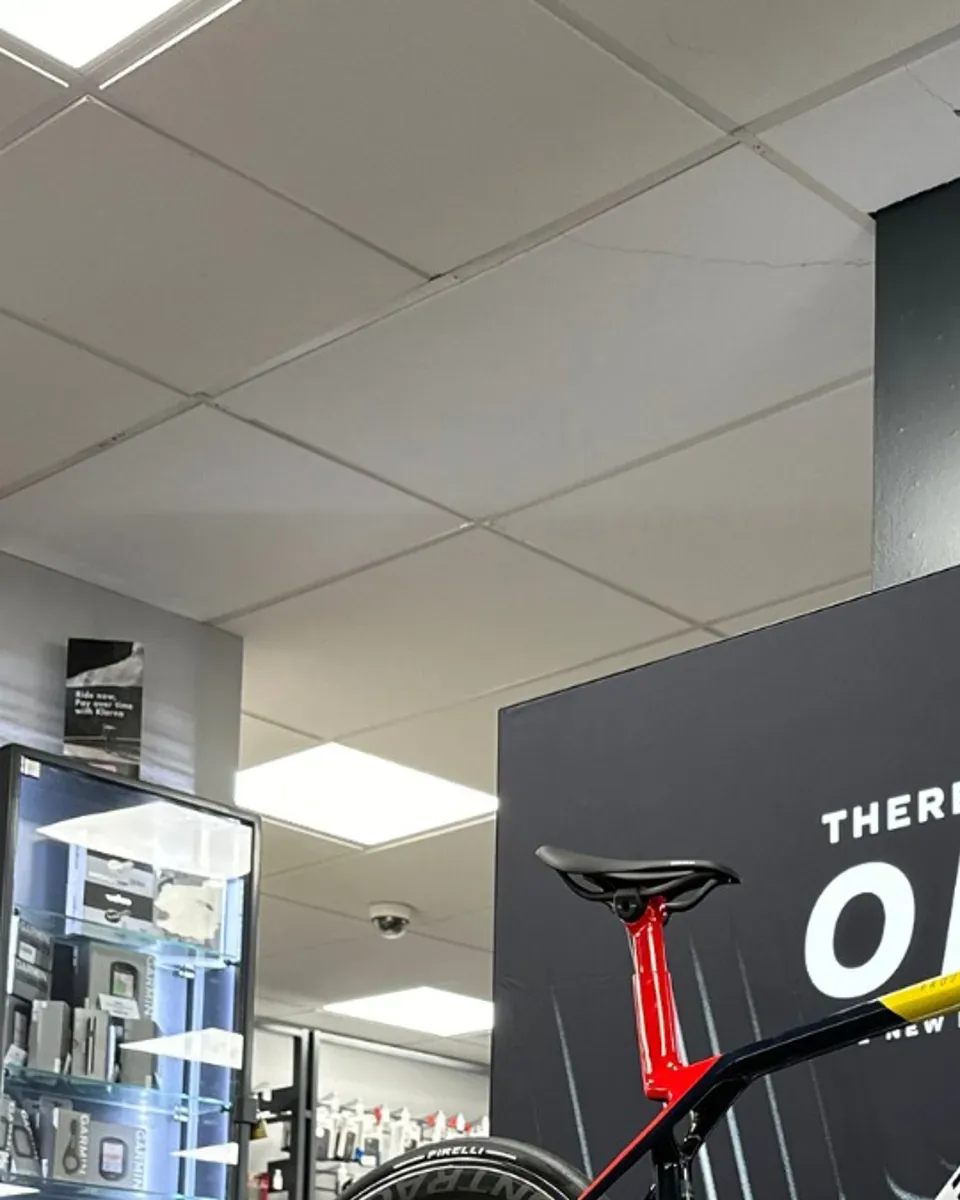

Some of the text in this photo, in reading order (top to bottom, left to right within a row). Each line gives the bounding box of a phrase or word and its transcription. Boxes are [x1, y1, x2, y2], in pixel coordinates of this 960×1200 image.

[78, 1113, 90, 1175] GARMIN
[132, 1129, 147, 1189] GARMIN
[426, 1146, 484, 1159] PIRELLI
